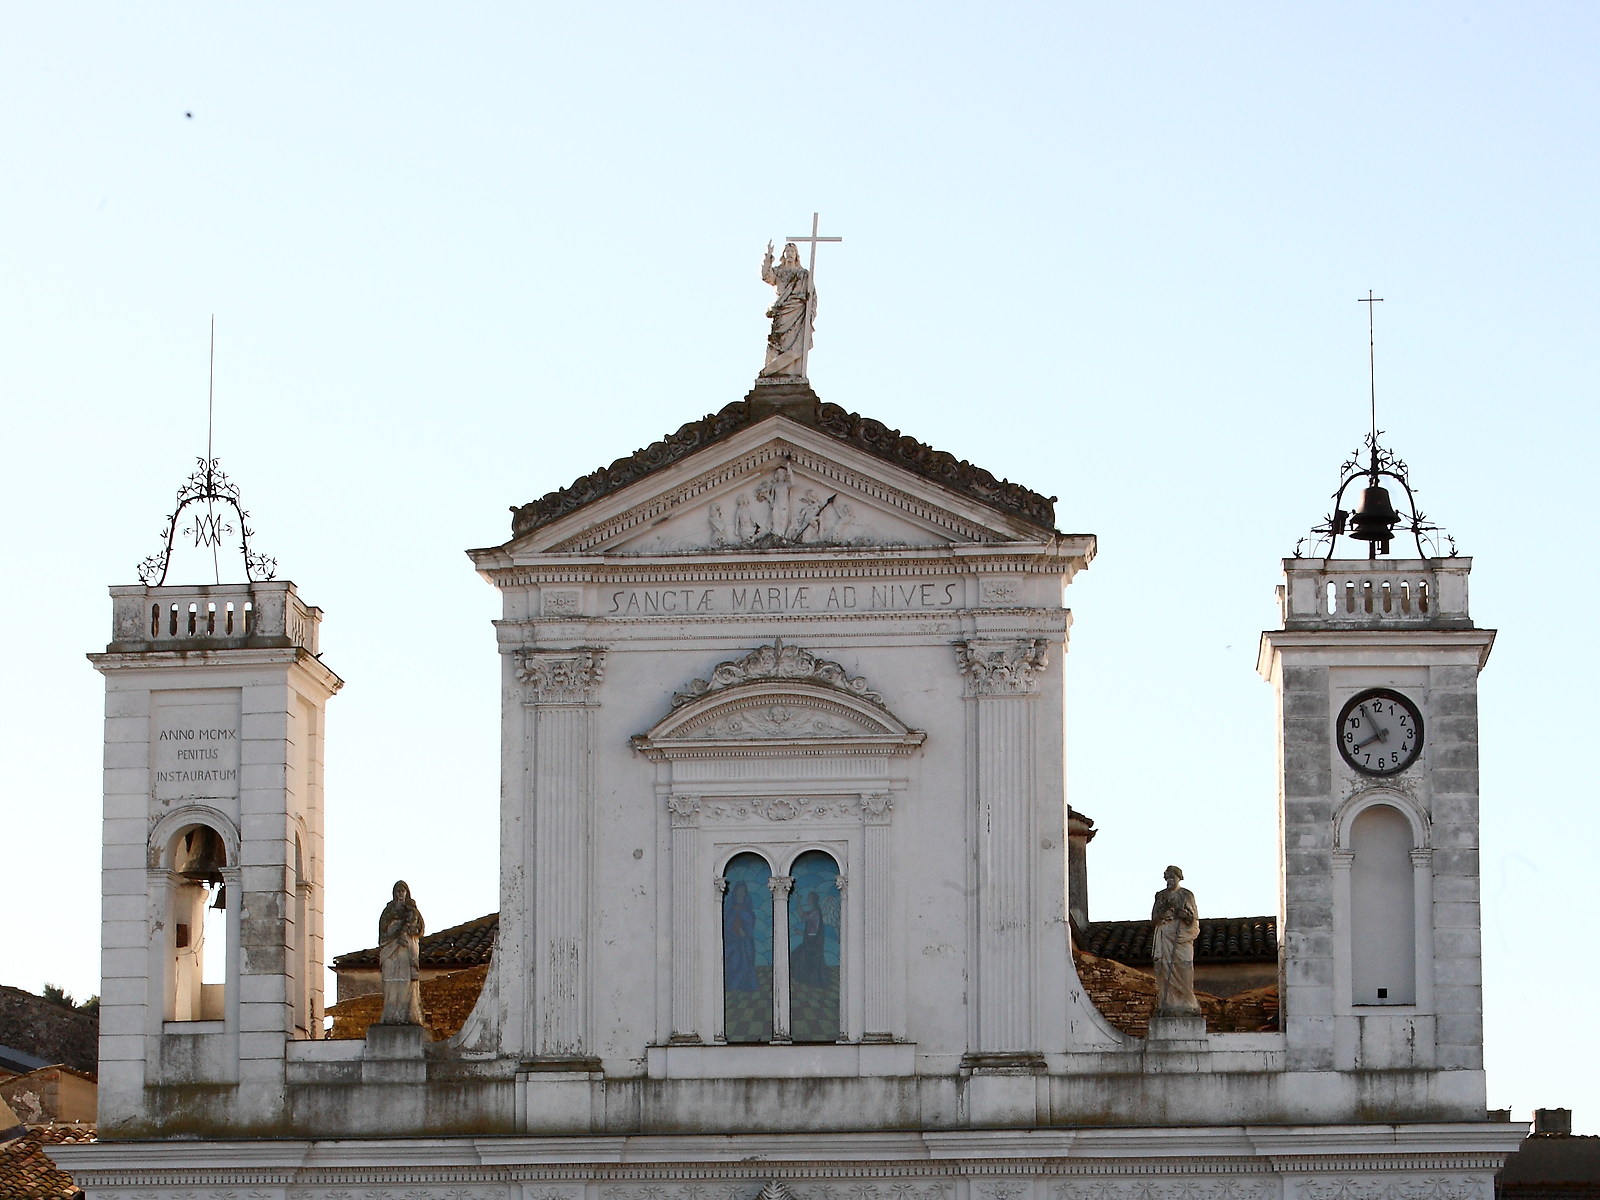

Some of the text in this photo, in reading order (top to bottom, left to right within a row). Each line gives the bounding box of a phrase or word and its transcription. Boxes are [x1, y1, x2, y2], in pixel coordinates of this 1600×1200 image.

[608, 583, 957, 613] SANCTÆ MARIÆ AD NIVES
[1372, 702, 1382, 713] 12
[1389, 706, 1394, 716] 1
[1350, 718, 1360, 728] 10
[1400, 716, 1406, 726] 2
[159, 729, 237, 740] ANNO MCMX
[1347, 733, 1353, 743] 9
[1407, 729, 1413, 739] 3
[1353, 744, 1360, 755] 8
[1402, 742, 1407, 752] 4
[177, 749, 219, 760] PENITUS
[1365, 754, 1371, 764] 7
[1392, 752, 1398, 762] 5
[1378, 758, 1385, 769] 6
[157, 769, 237, 782] INSTAURATUM
